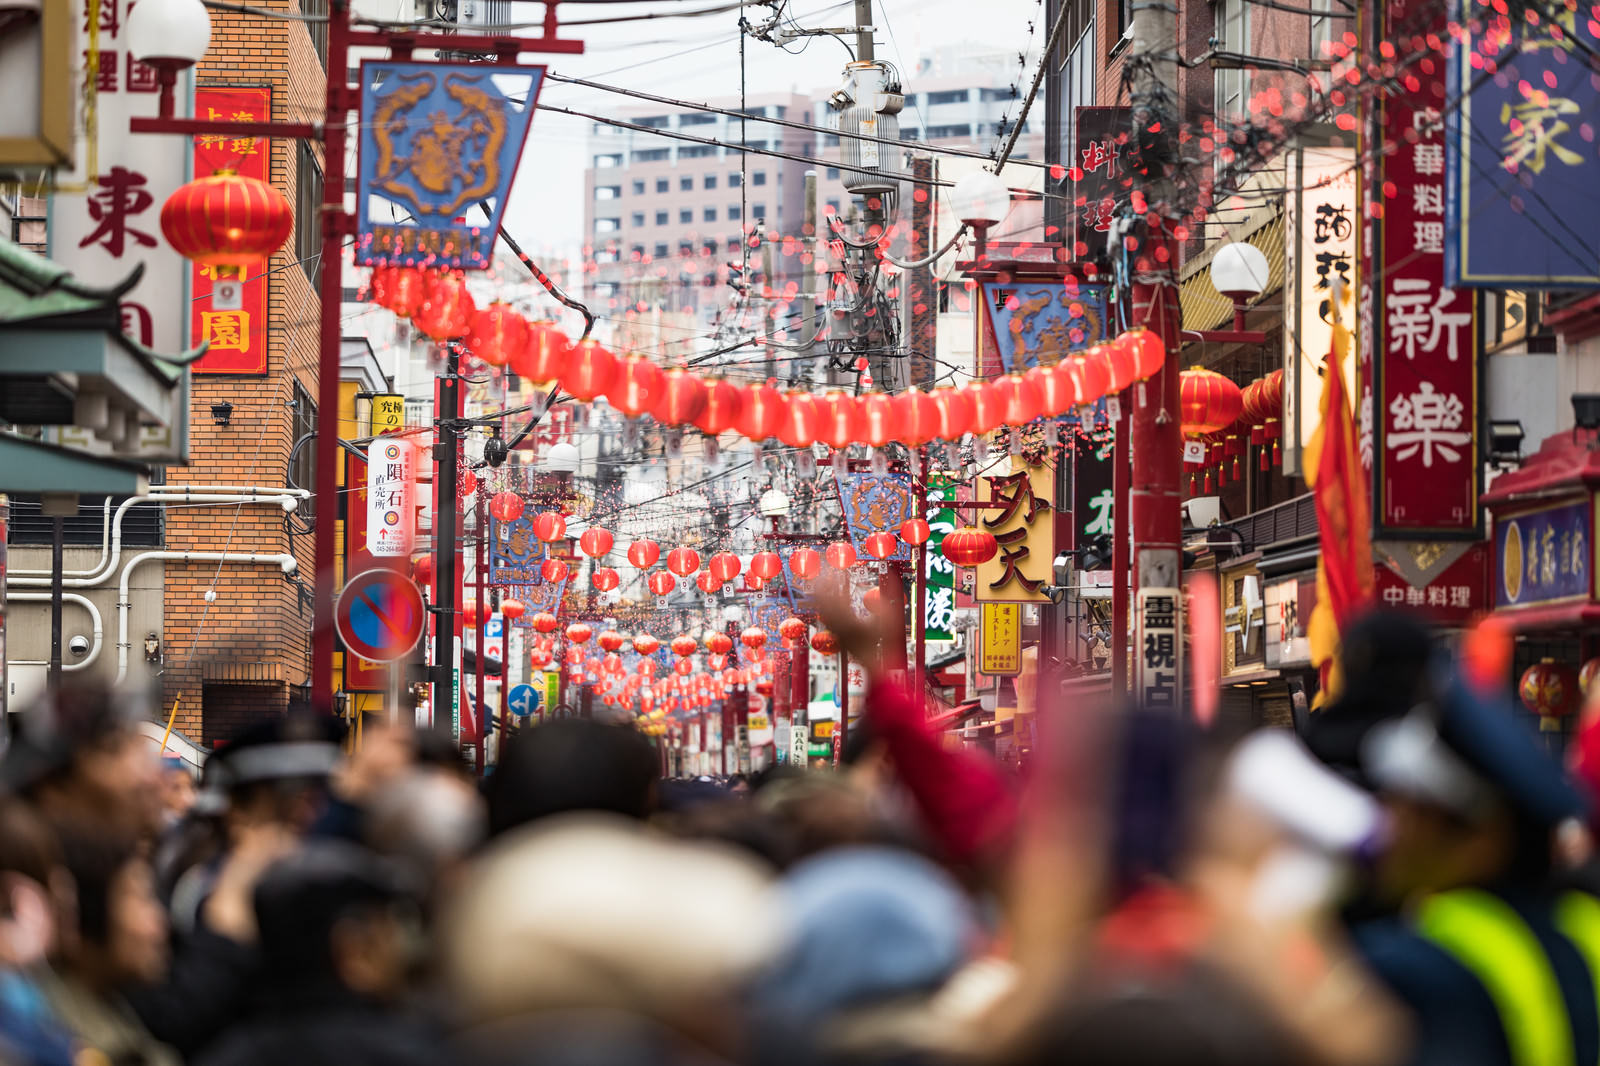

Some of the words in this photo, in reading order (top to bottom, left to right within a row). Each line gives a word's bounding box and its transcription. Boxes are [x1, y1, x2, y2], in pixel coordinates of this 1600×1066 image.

[1082, 140, 1119, 232] 料理
[375, 474, 386, 510] 直売所
[387, 463, 403, 507] 隕石
[1383, 585, 1470, 608] 中華料理
